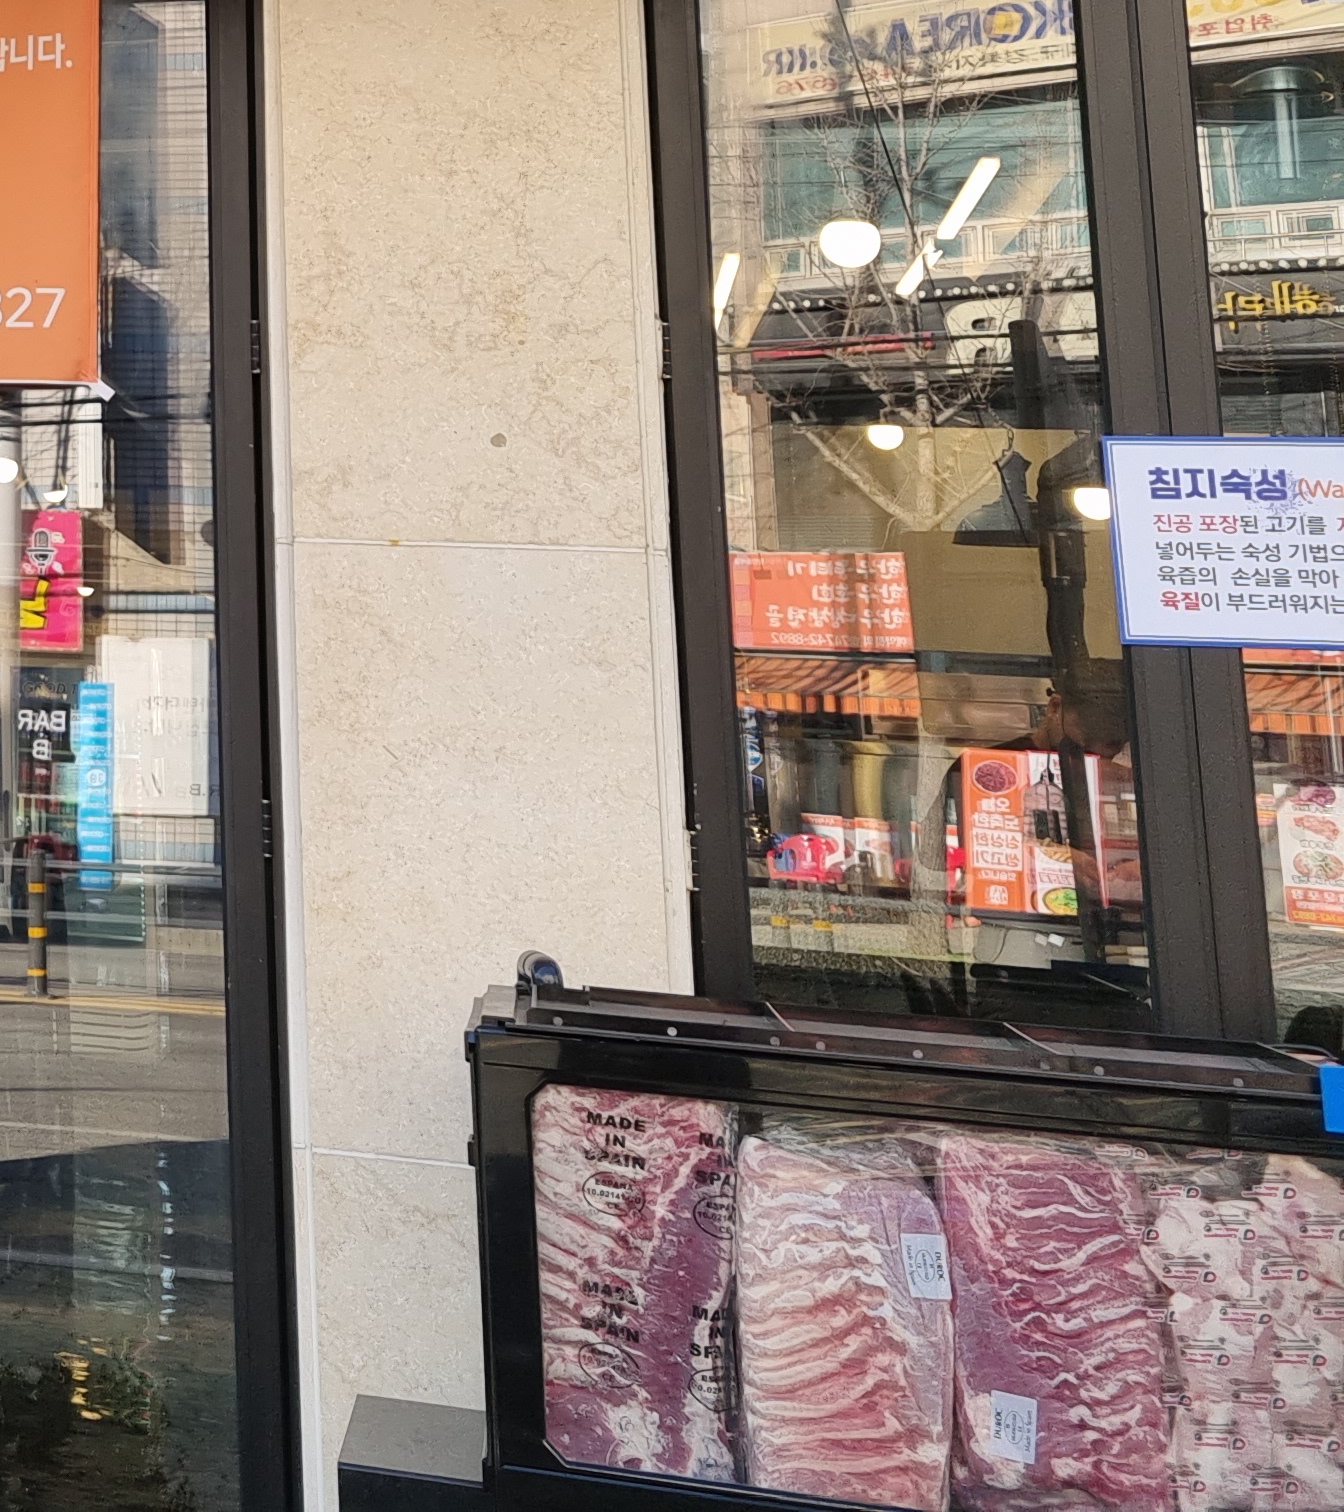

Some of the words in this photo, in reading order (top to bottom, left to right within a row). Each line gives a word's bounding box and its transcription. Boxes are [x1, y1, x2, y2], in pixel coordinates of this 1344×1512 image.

[1148, 466, 1288, 501] 침지숙성
[1153, 513, 1193, 534] 진공
[1199, 514, 1259, 535] 포장된
[1265, 515, 1327, 536] 고기를
[1155, 541, 1236, 562] 넣어두는
[1240, 542, 1281, 563] 숙성
[1157, 565, 1218, 587] 육즙의
[1230, 567, 1293, 588] 손실을
[1298, 568, 1339, 589] 막아
[1160, 590, 1220, 612] 육질이
[586, 1111, 646, 1133] MADE
[605, 1133, 626, 1148] IN
